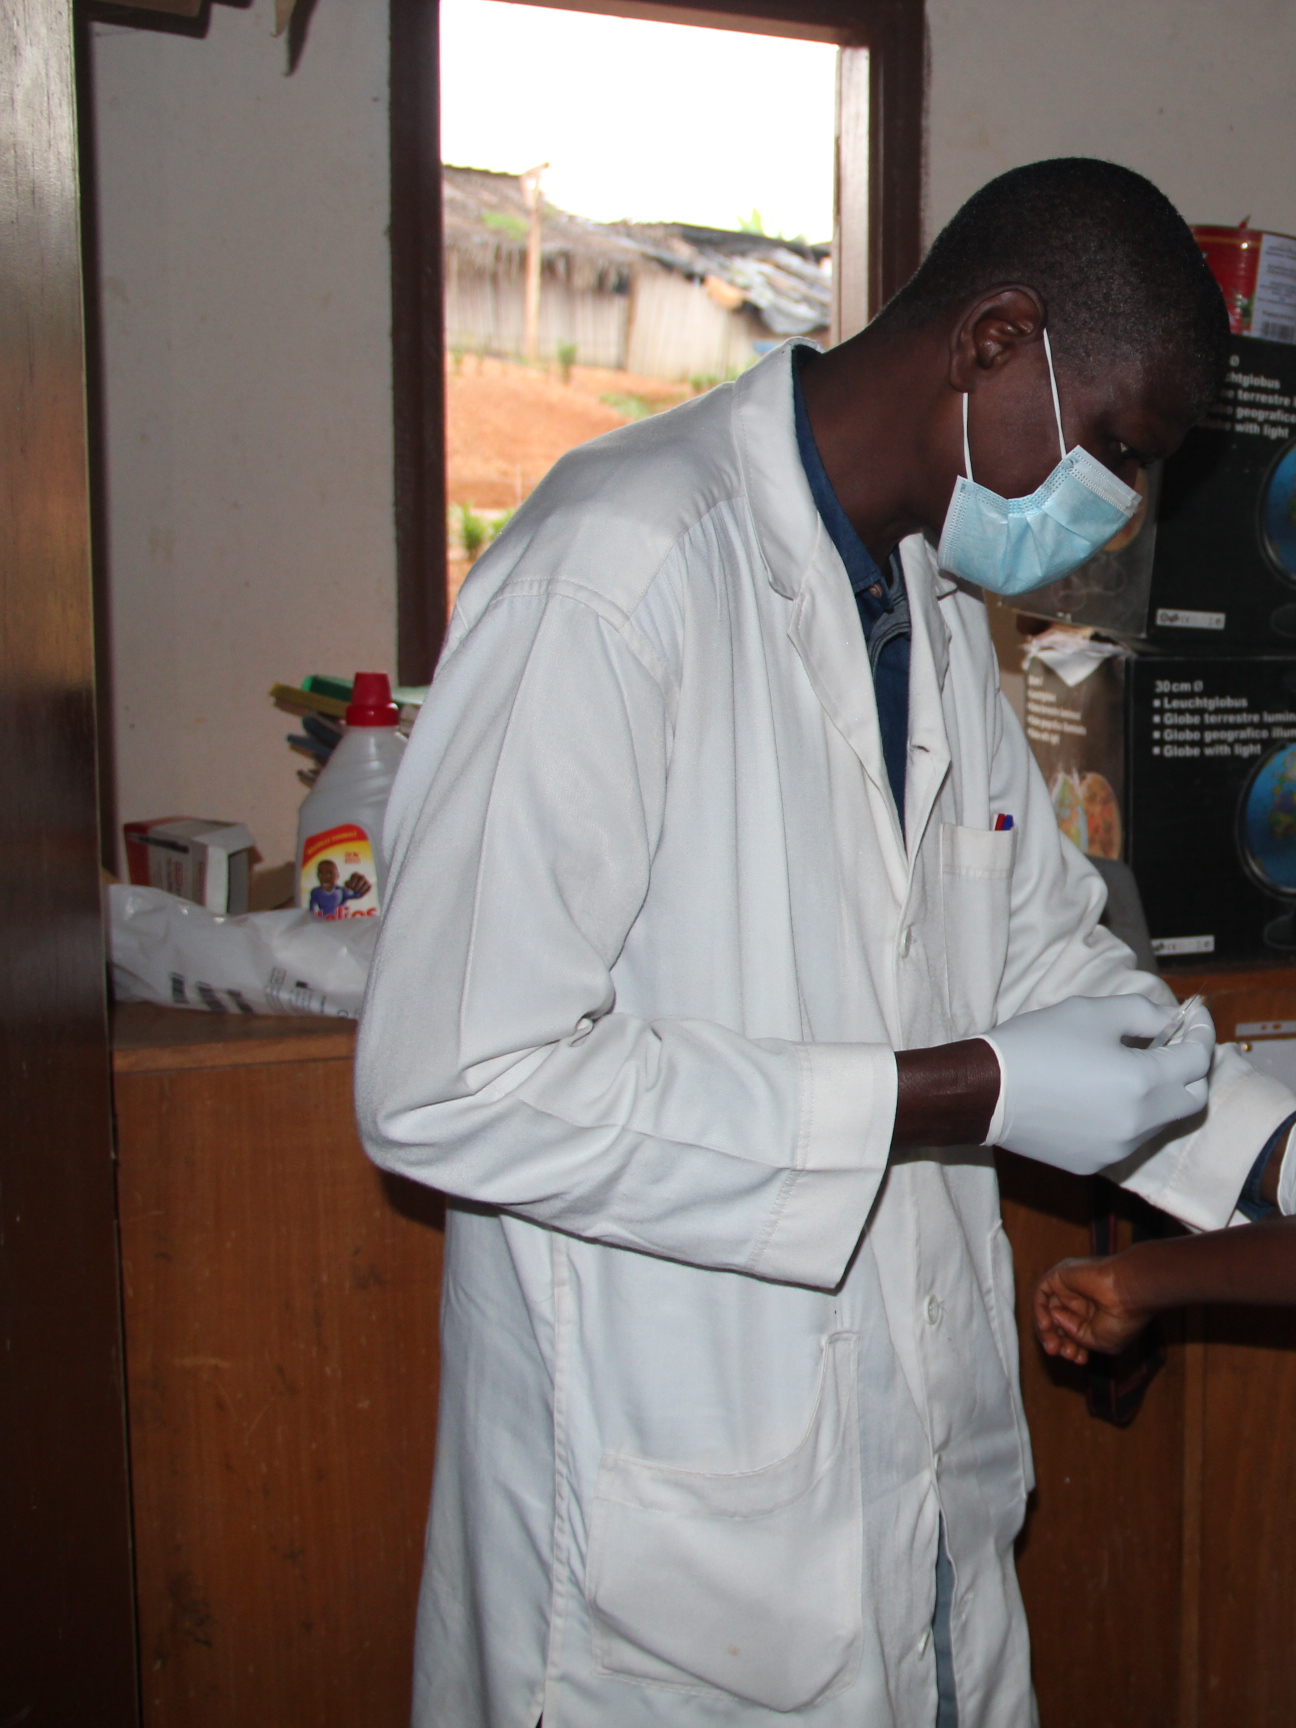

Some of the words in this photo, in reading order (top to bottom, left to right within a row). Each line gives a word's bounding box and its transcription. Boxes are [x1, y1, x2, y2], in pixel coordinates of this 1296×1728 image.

[1236, 389, 1291, 406] terrestre
[1234, 422, 1260, 435] with
[1263, 423, 1290, 440] light
[1163, 696, 1248, 711] Leuchtglobus
[1163, 712, 1200, 725] Globe
[1204, 712, 1260, 723] terrestre
[1163, 728, 1200, 741] Globo
[1203, 727, 1268, 742] geografico
[1163, 744, 1200, 758] Globe
[1203, 744, 1231, 756] with
[1233, 743, 1262, 758] light
